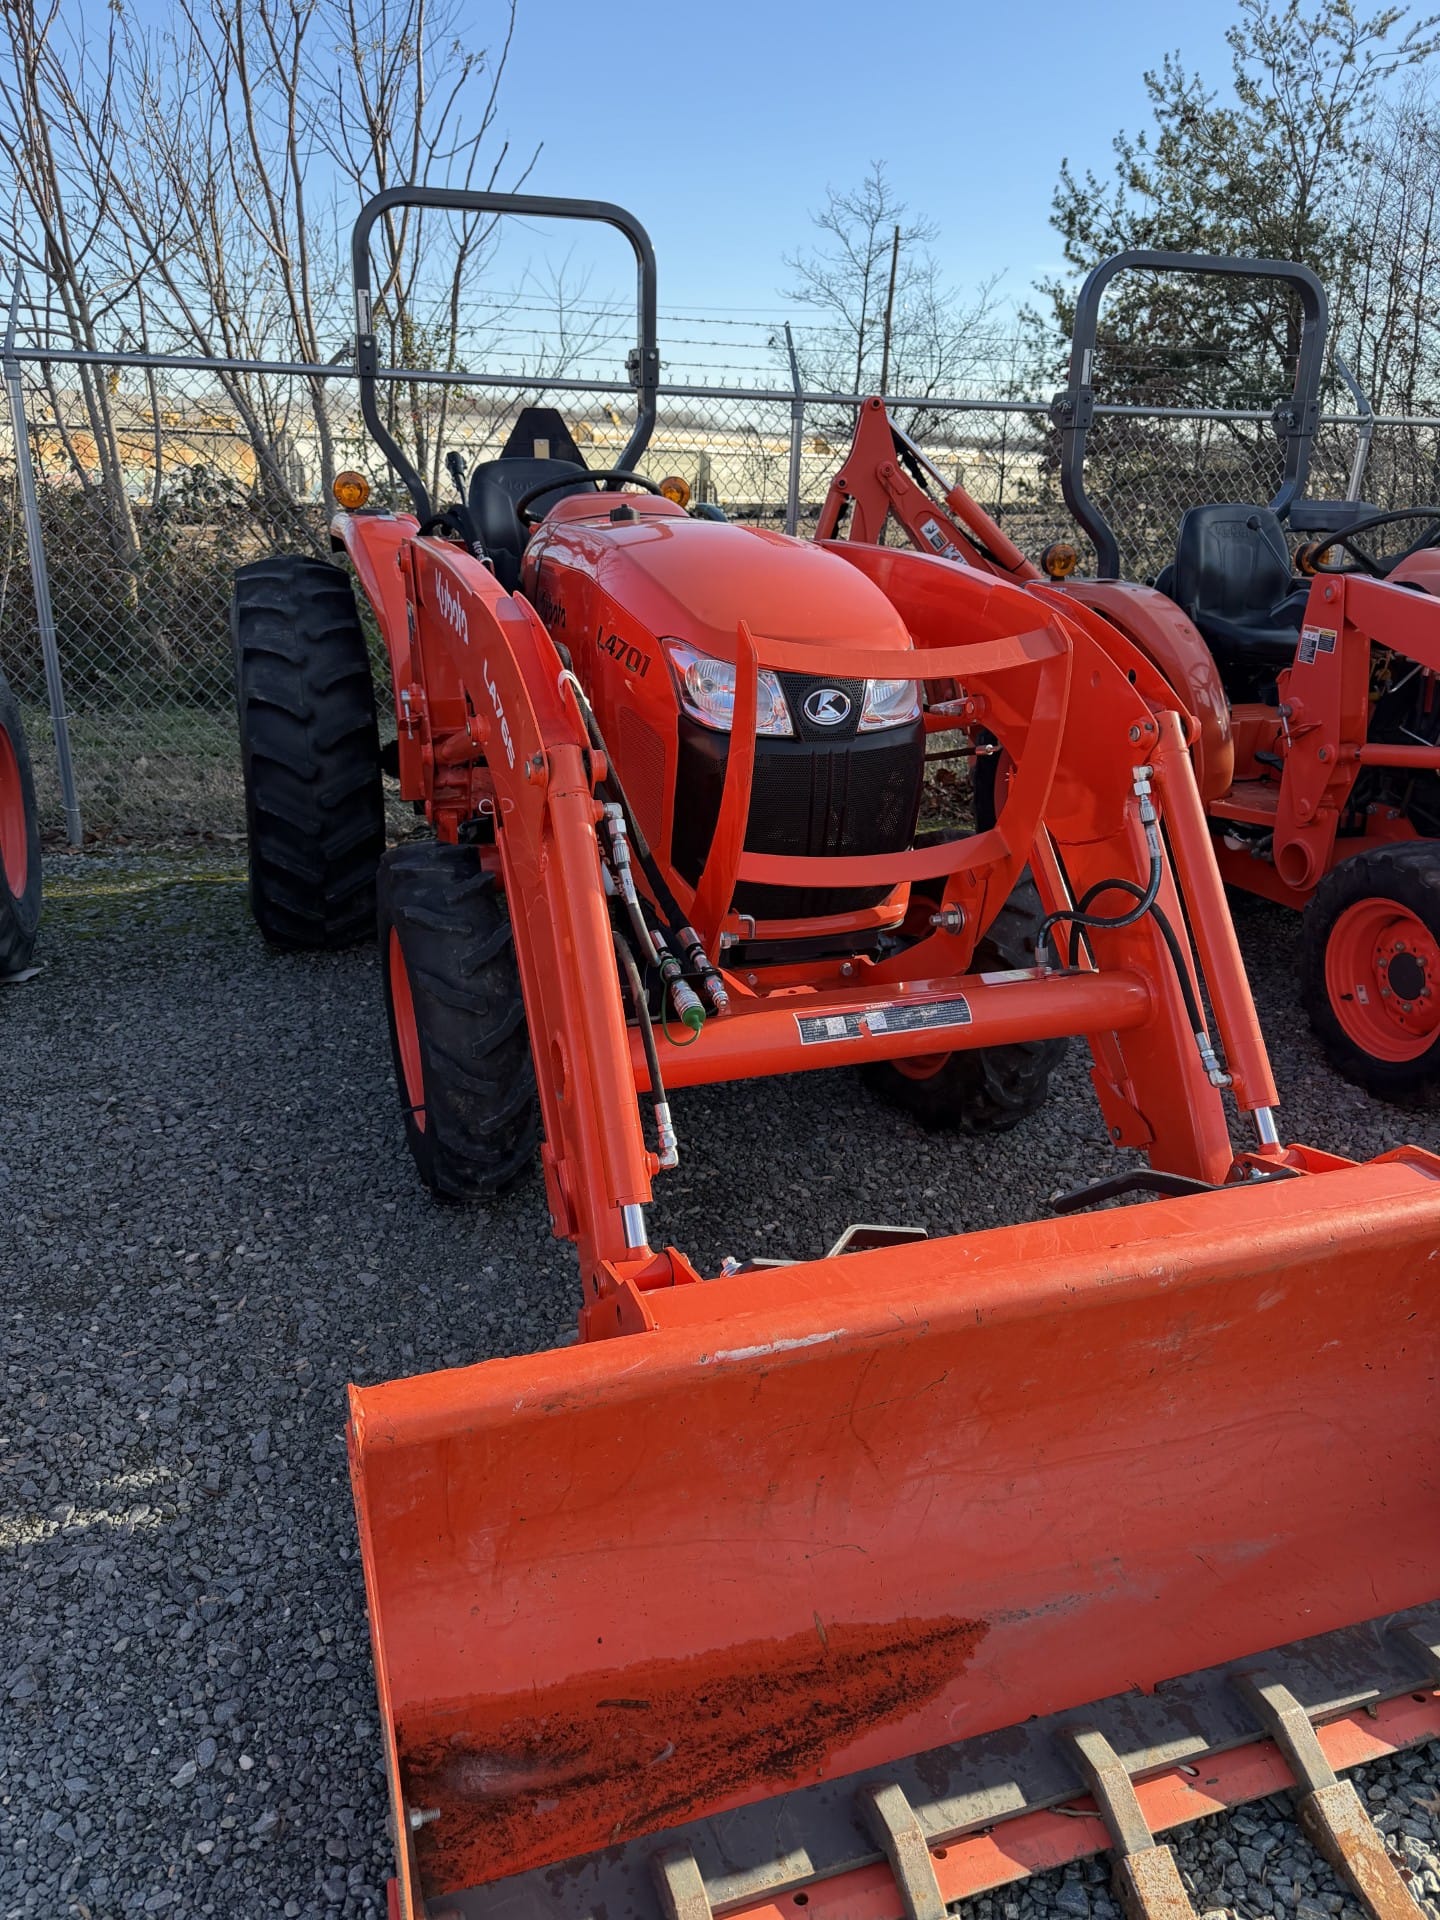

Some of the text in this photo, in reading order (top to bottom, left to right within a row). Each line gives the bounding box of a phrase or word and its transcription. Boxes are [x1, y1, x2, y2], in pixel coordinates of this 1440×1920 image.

[435, 567, 469, 646] Kubota
[596, 624, 652, 678] L4701
[482, 657, 516, 769] LA765
